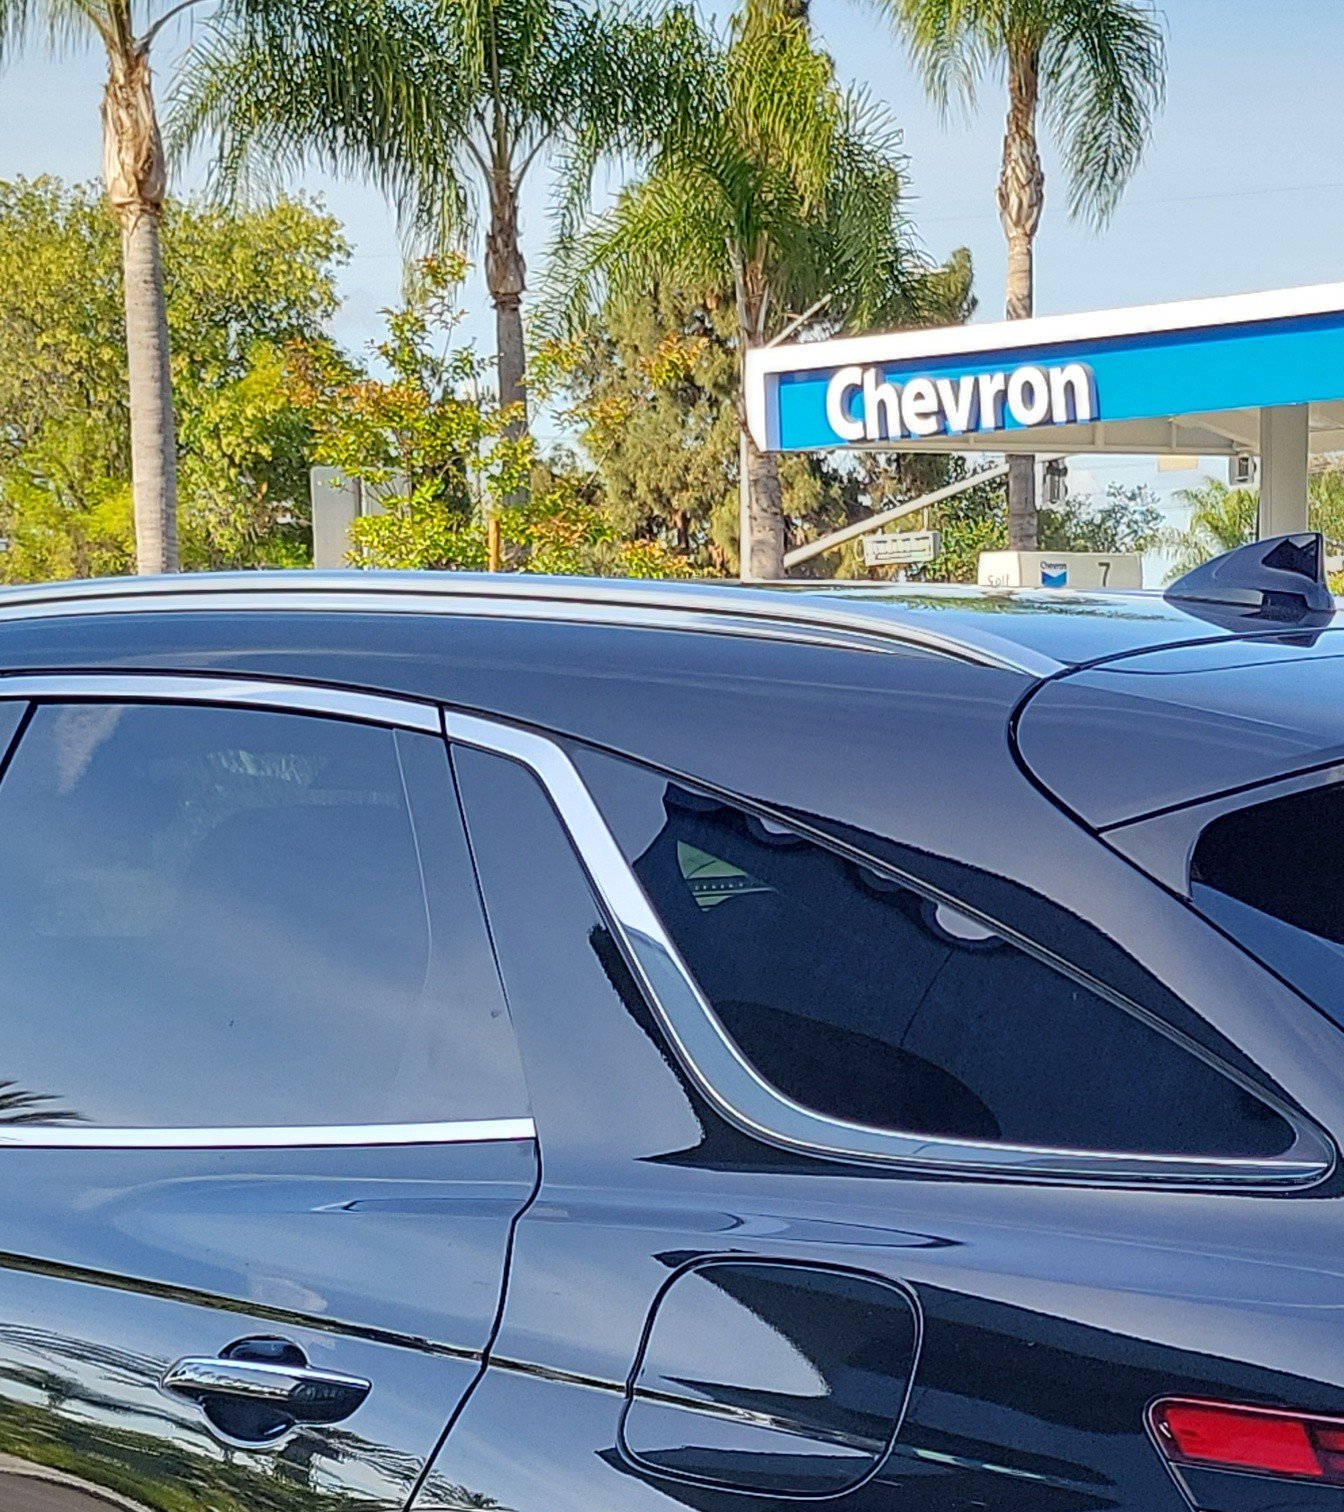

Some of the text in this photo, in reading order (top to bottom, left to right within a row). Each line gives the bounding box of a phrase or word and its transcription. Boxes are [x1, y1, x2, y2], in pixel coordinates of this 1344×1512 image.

[826, 363, 1096, 442] Chevron
[1040, 561, 1067, 571] Chevron
[1098, 562, 1111, 587] 7
